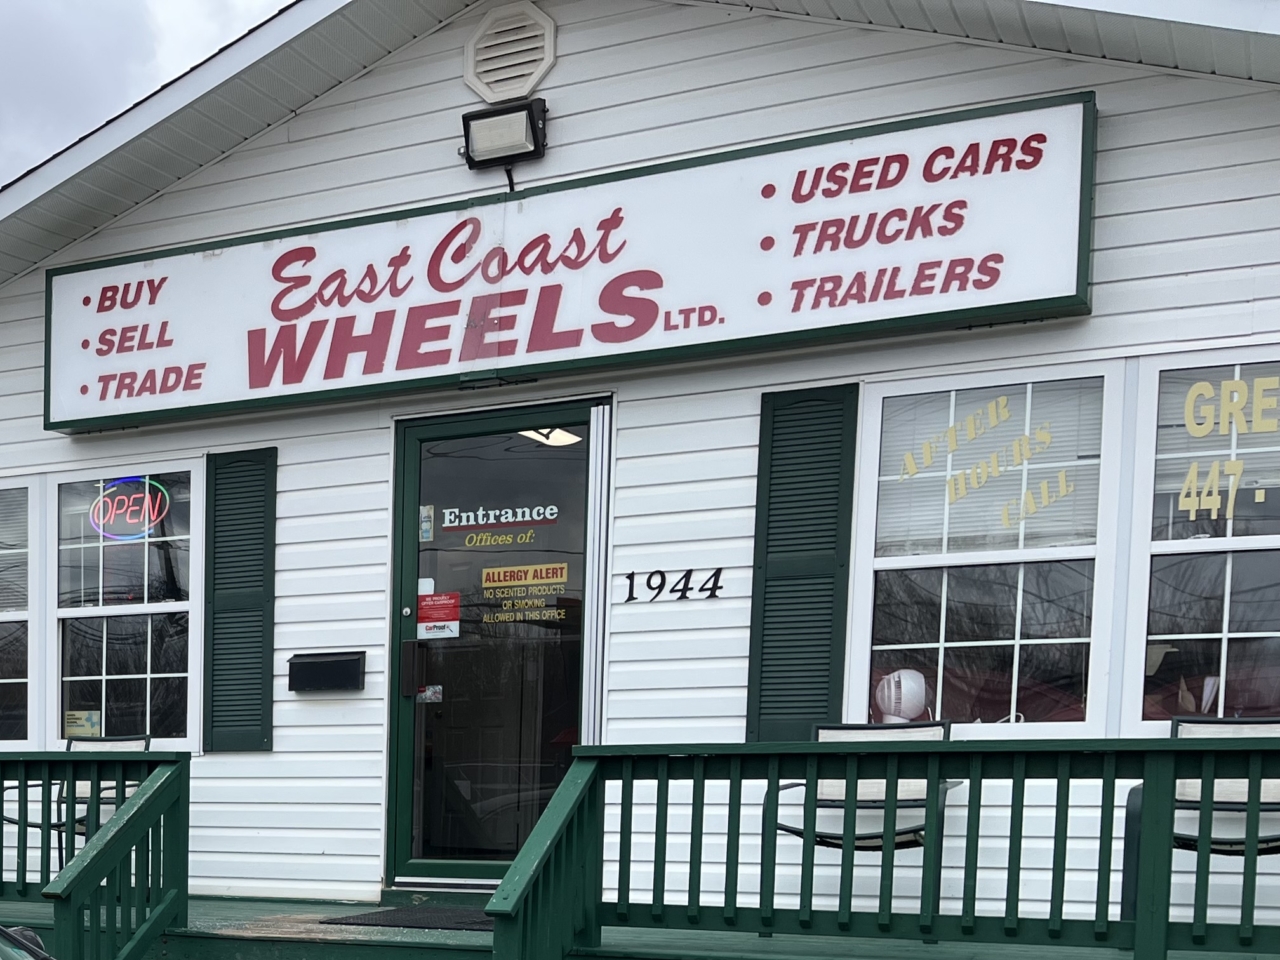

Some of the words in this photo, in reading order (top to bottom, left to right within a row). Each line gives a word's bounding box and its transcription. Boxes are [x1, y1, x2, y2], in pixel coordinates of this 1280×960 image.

[791, 153, 909, 204] USED
[922, 133, 1048, 183] CARS
[792, 199, 969, 257] TRUCKS
[271, 245, 414, 322] East
[426, 206, 627, 293] Coast
[790, 253, 1004, 313] TRAILERS
[96, 276, 168, 313] BUY
[95, 321, 174, 357] SELL
[247, 269, 664, 389] WHEELS
[664, 305, 725, 331] LTD.
[97, 362, 207, 401] TRADE
[1184, 376, 1280, 438] GRE
[898, 395, 1012, 483] AFTER
[946, 422, 1053, 505] HOURS
[94, 491, 162, 525] OPEN
[442, 505, 558, 527] Entrance
[1001, 469, 1074, 528] CALL
[465, 532, 513, 547] Offices
[517, 530, 535, 543] of:
[484, 589, 494, 598] NO
[496, 587, 527, 598] SCENTED
[528, 585, 565, 596] PRODUCTS
[485, 569, 529, 583] ALLERGY
[532, 567, 565, 580] ALERT
[624, 567, 724, 603] 1944
[483, 612, 515, 623] ALLOWED
[516, 612, 523, 621] IN
[525, 611, 540, 620] THIS
[542, 609, 566, 620] OFFICE
[502, 600, 513, 610] OR
[515, 598, 545, 609] SMOKING
